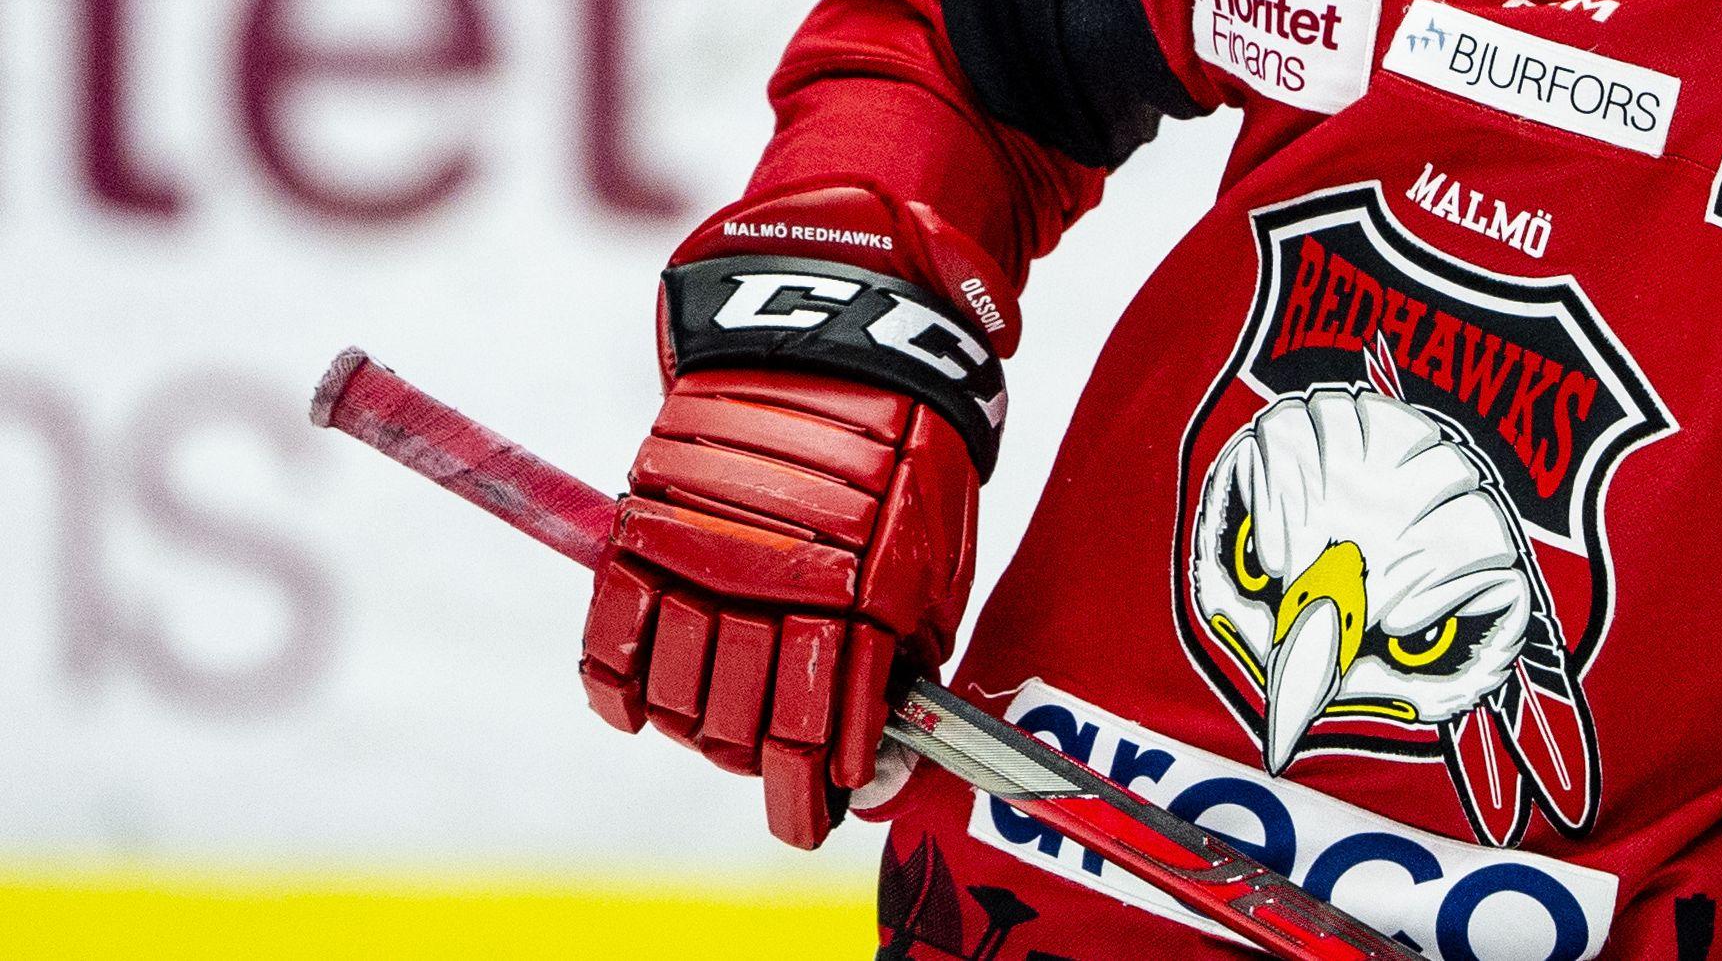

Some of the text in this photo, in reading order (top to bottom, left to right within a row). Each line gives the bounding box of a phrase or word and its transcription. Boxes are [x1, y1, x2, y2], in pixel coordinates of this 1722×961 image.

[1212, 11, 1305, 92] Finans
[1448, 33, 1662, 134] BJURFORS
[723, 222, 893, 251] MALMÖ REDHAWKS
[1405, 162, 1554, 259] MALMÖ
[712, 272, 1007, 429] CC
[960, 277, 1006, 334] OLSSON
[1271, 234, 1599, 499] REDHAWKS
